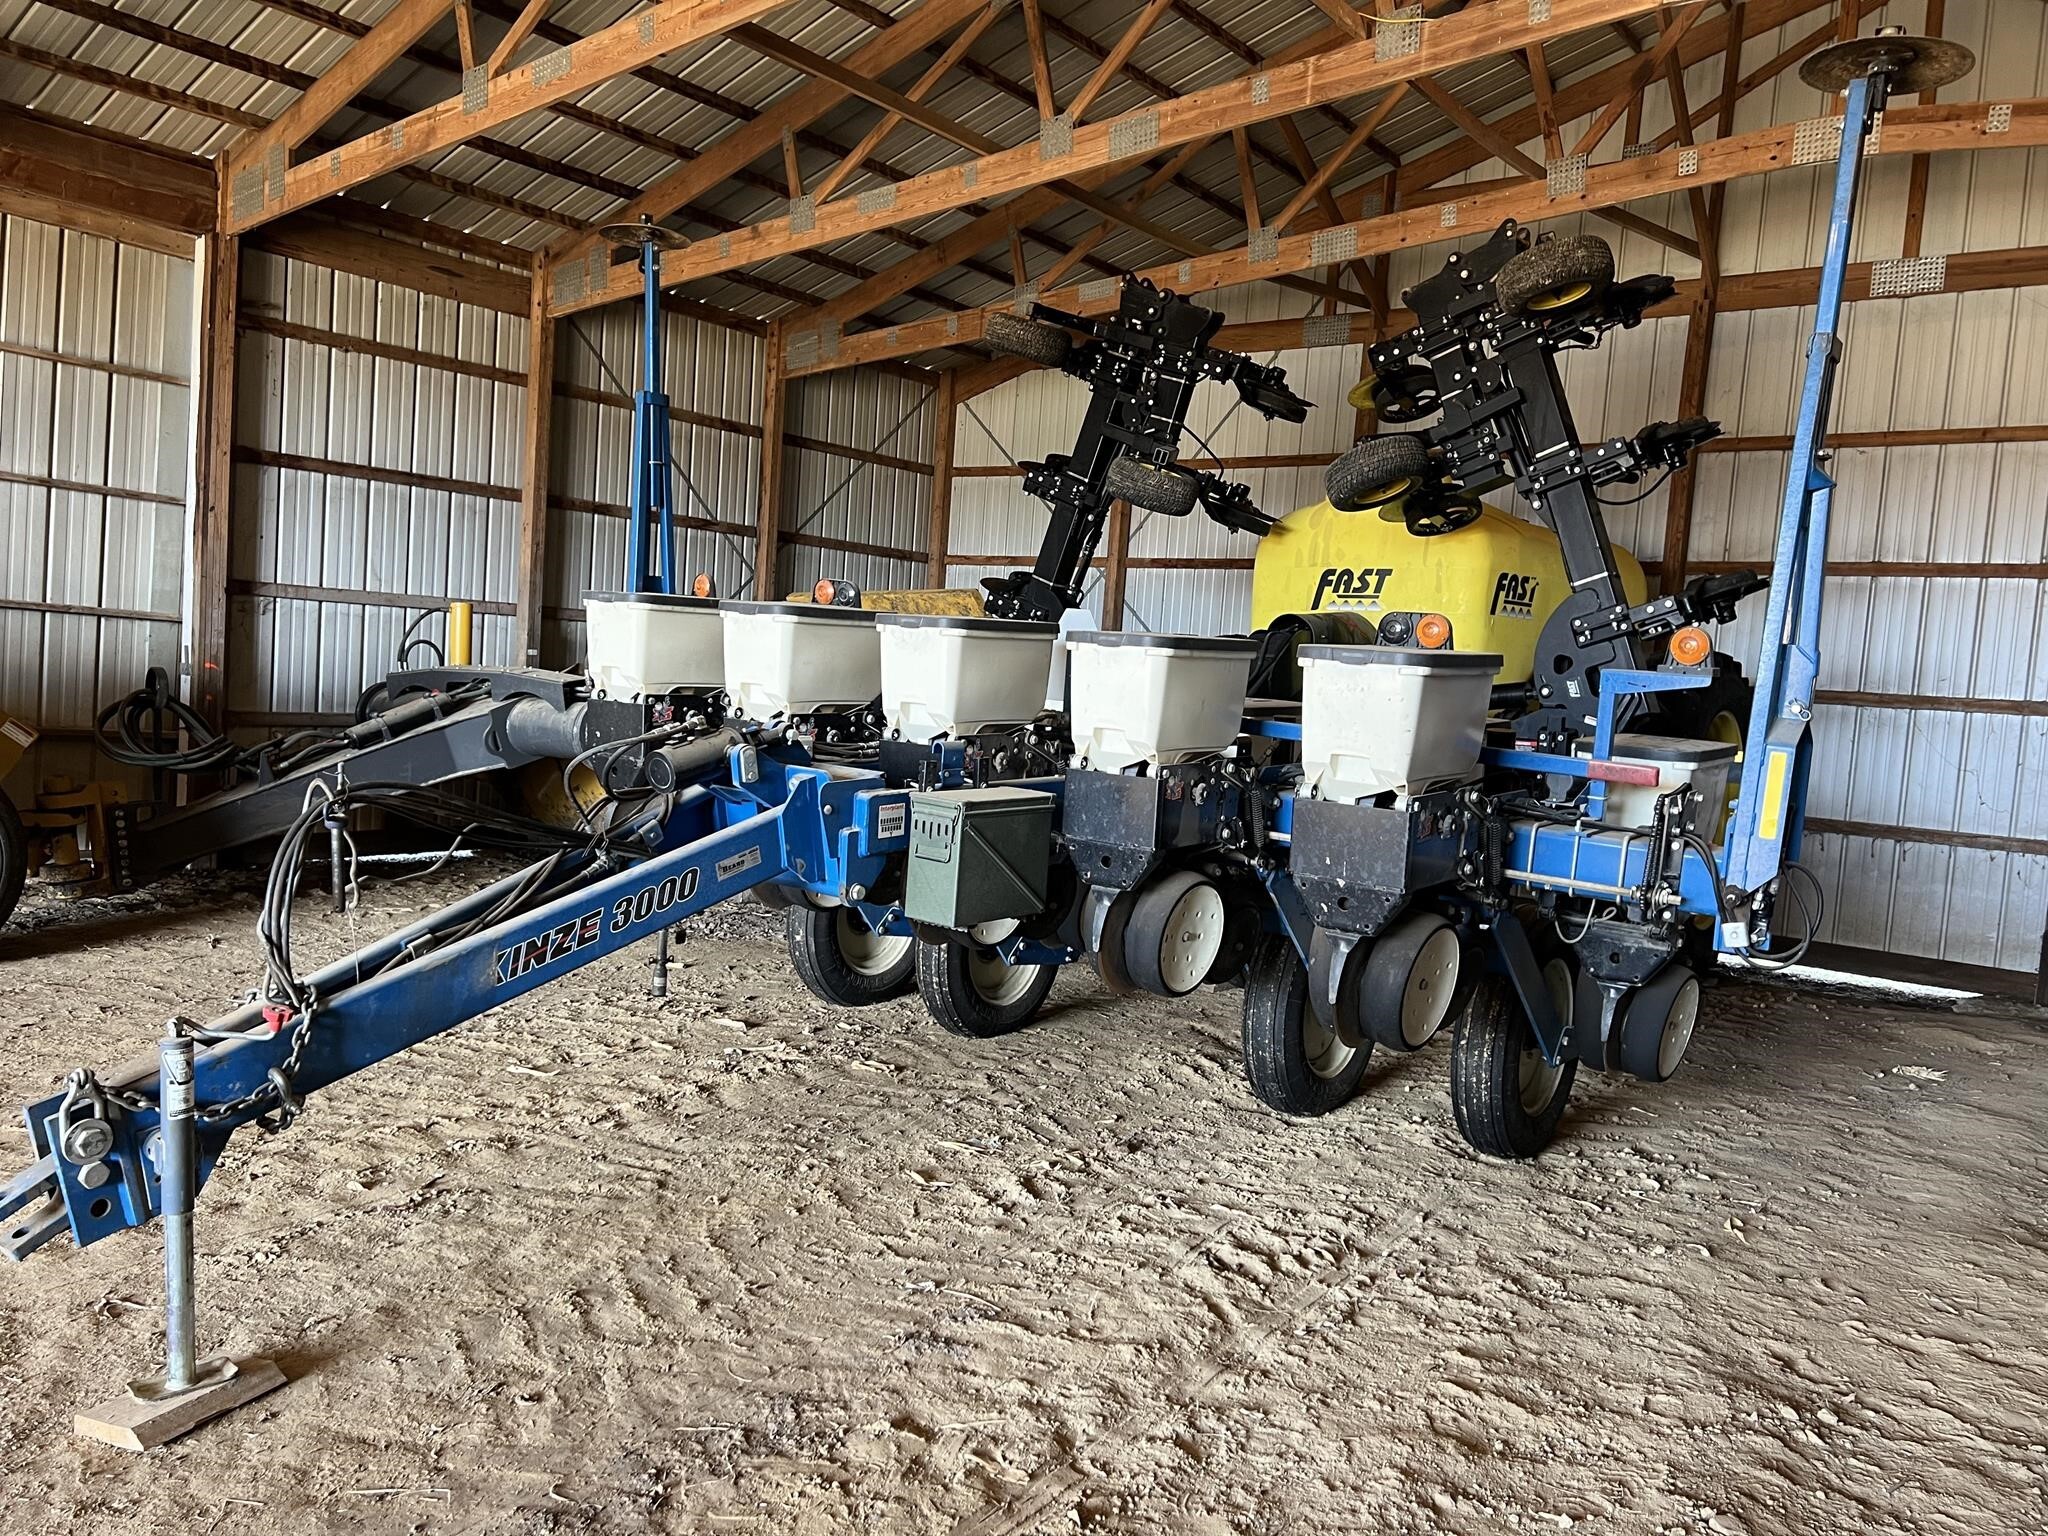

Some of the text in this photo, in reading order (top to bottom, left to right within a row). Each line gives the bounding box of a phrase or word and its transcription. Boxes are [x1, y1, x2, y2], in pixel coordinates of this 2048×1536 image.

[1310, 568, 1393, 611] FAST
[496, 867, 700, 986] KINZE 3000
